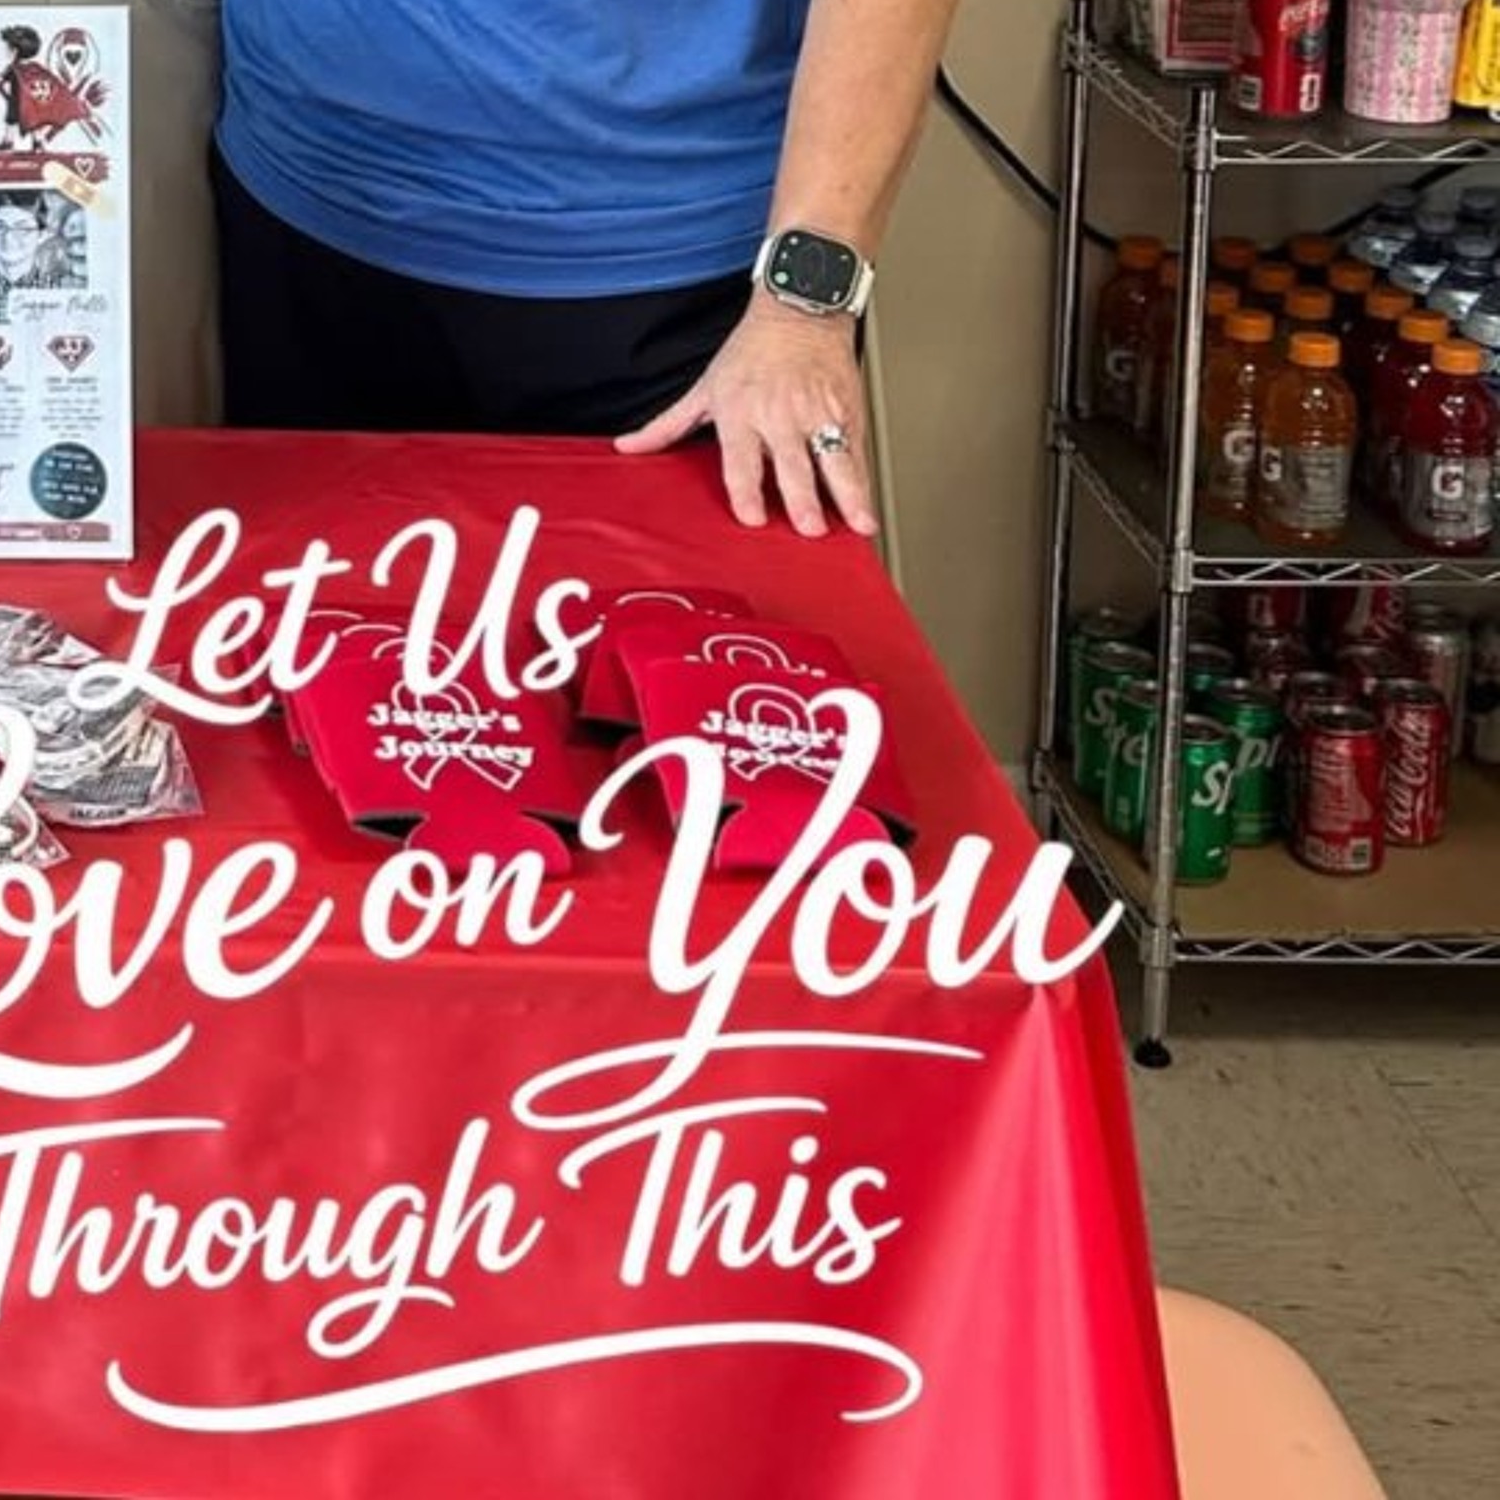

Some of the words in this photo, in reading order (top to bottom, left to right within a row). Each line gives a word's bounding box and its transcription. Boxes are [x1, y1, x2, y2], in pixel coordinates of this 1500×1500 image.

[1432, 465, 1464, 499] G
[366, 703, 522, 738] Jagger's
[374, 735, 534, 768] Journey
